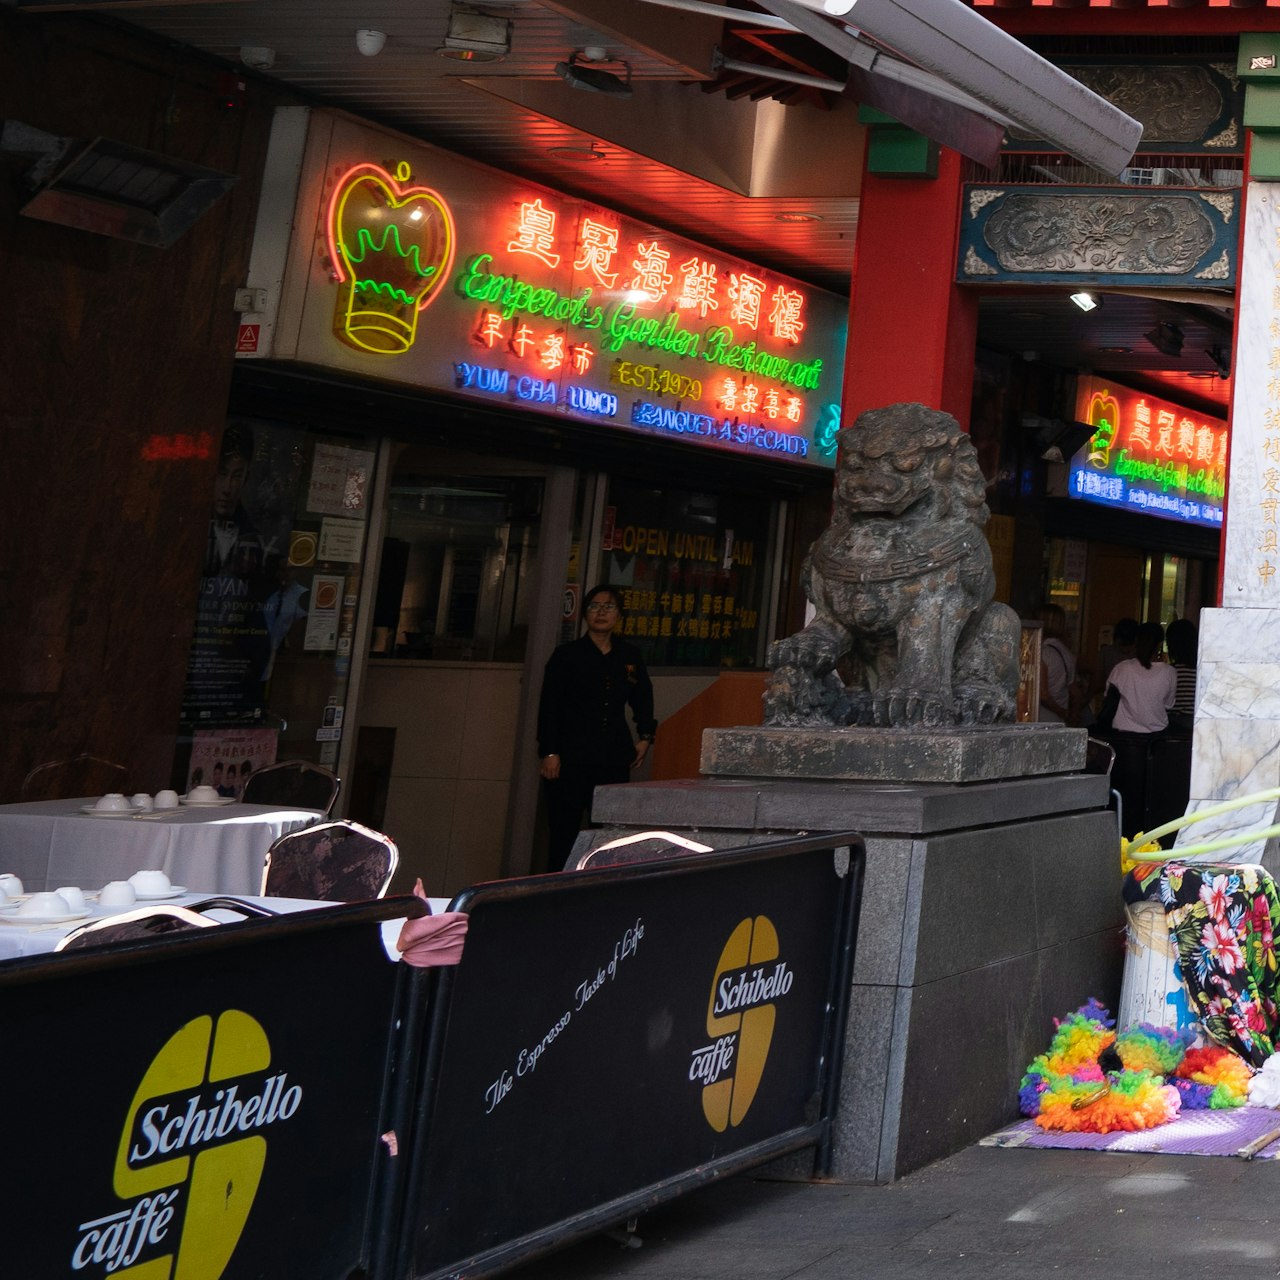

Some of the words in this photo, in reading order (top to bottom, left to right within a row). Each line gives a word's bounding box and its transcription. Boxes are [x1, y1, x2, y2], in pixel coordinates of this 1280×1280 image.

[609, 299, 700, 357] Garden
[703, 326, 823, 390] Restaurant
[462, 363, 509, 394] YUM
[517, 376, 557, 404] CHA
[569, 386, 618, 416] LUNCH
[623, 524, 669, 556] OPEN
[674, 532, 719, 563] UNTIL
[485, 1071, 514, 1114] The
[517, 1011, 572, 1077] Espresso
[576, 968, 606, 1011] Taste
[608, 942, 621, 980] of
[621, 918, 645, 960] Life
[714, 962, 794, 1014] Schibello
[689, 1035, 736, 1085] caffé
[130, 1073, 303, 1162] Schibello
[72, 1189, 179, 1272] caffé
